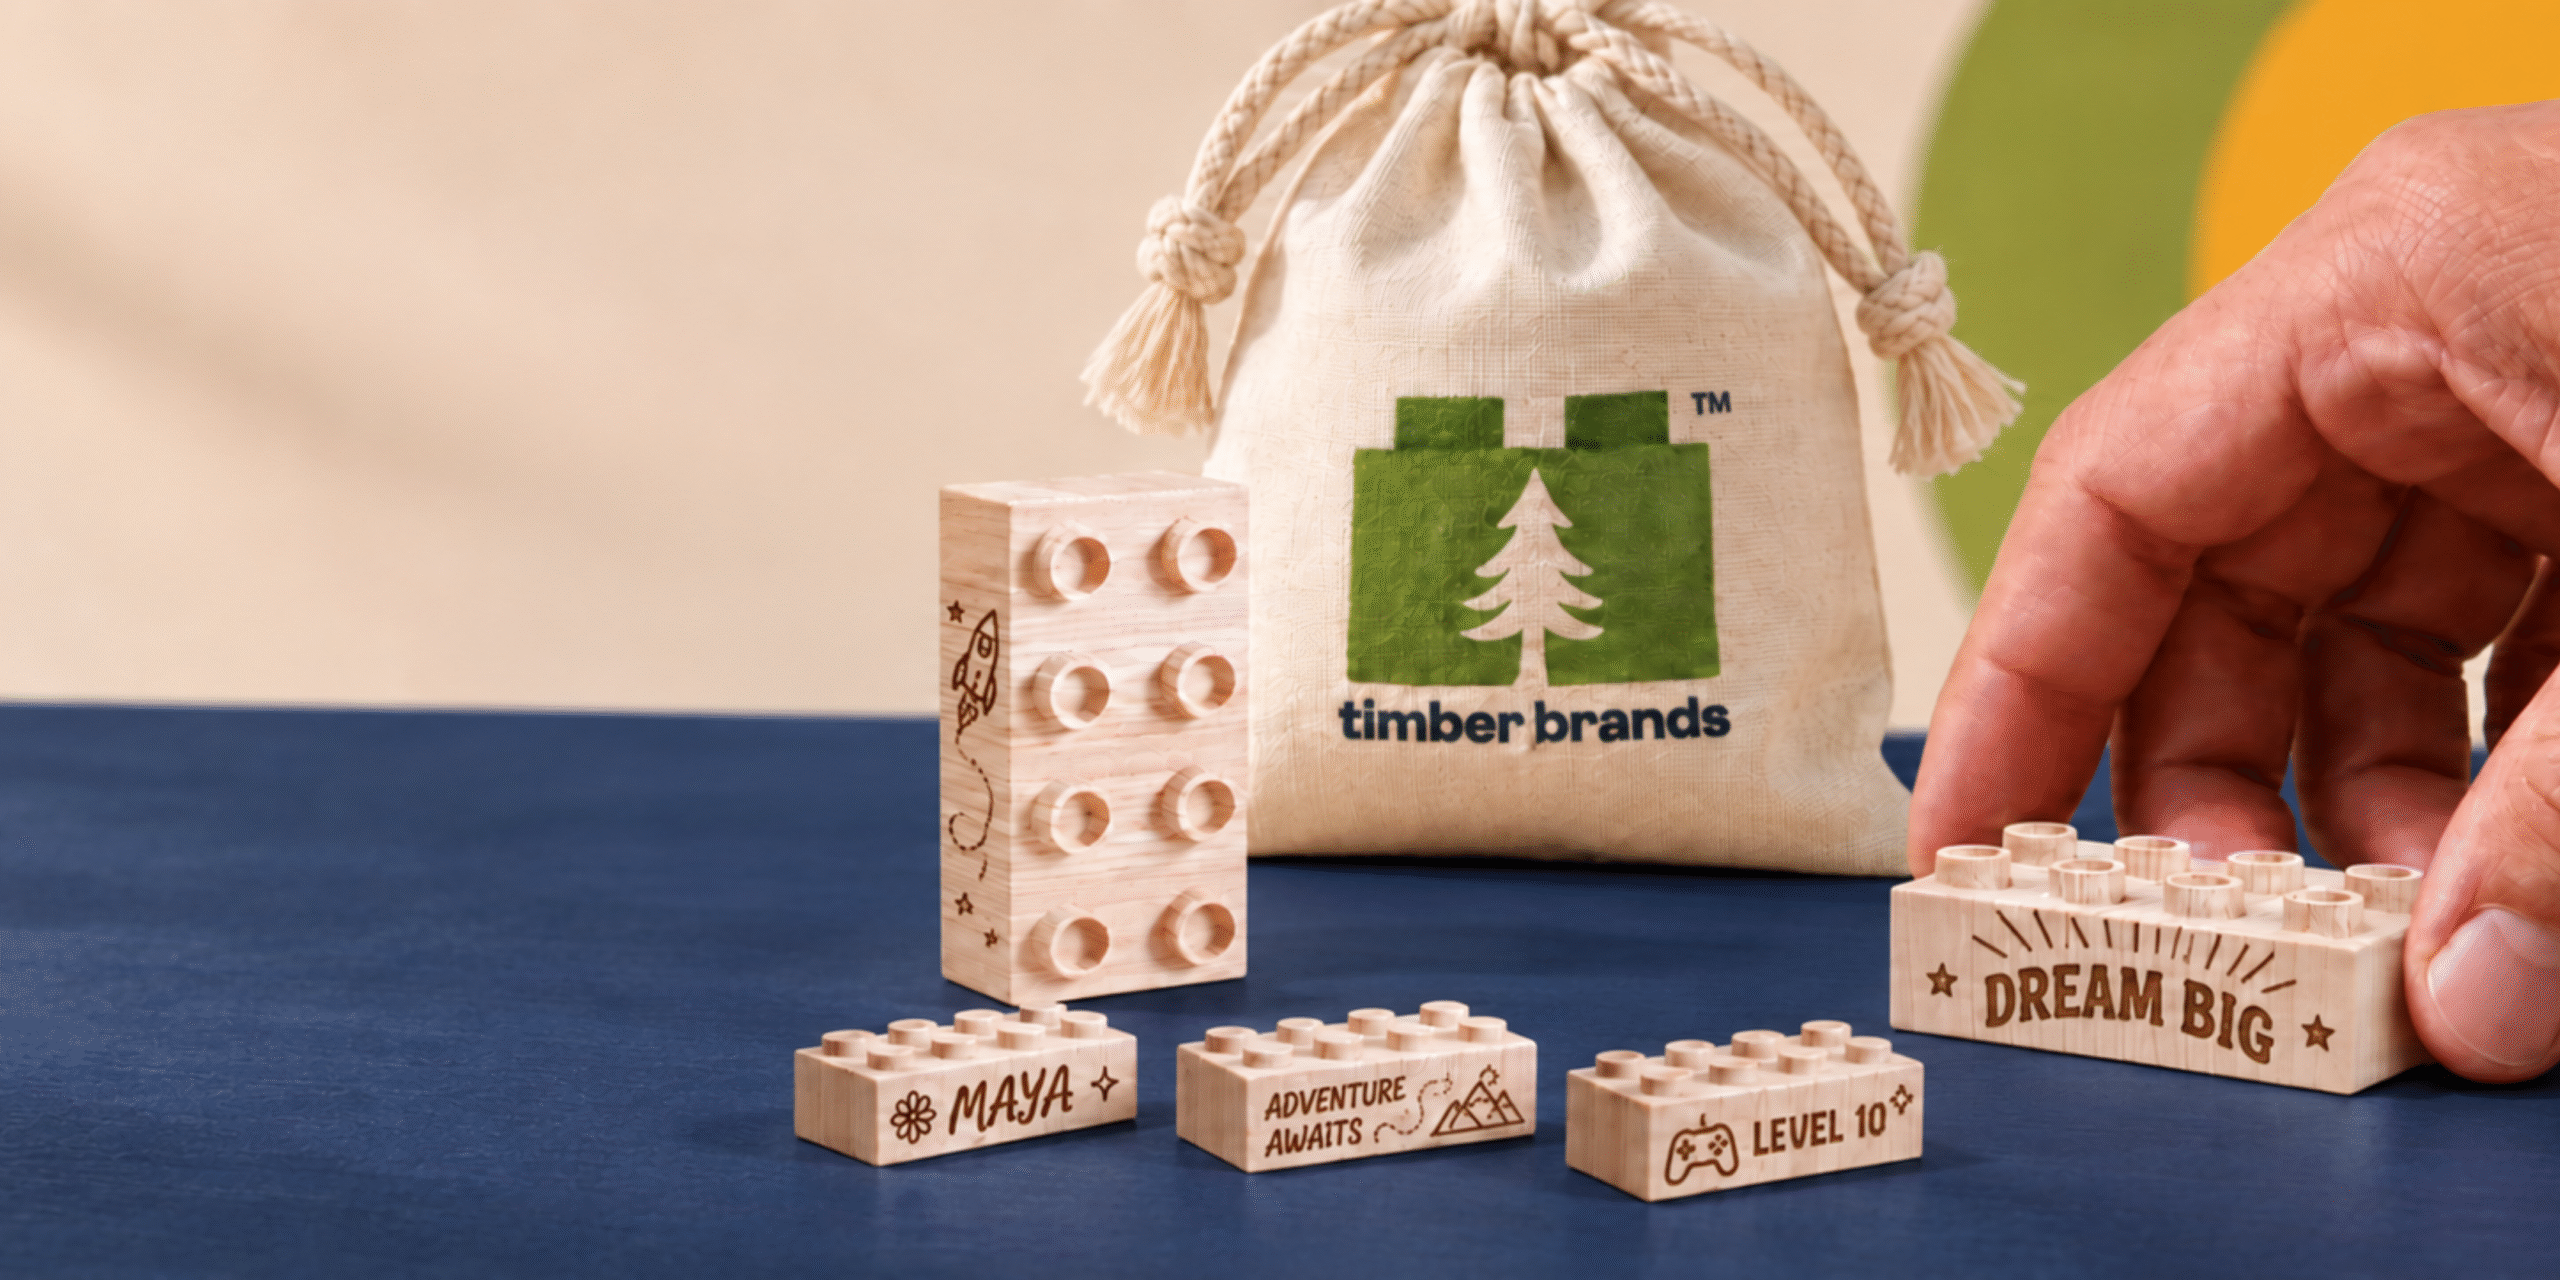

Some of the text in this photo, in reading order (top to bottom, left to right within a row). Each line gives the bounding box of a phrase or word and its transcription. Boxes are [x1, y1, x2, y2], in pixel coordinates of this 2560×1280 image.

[1691, 391, 1732, 415] TM
[1338, 696, 1731, 743] timber brands
[1984, 962, 2275, 1065] DREAM BIG
[949, 1064, 1074, 1135] MAYA
[1264, 1075, 1407, 1121] ADVENTURE
[1264, 1117, 1364, 1158] AWAITS
[1753, 1101, 1887, 1157] LEVEL 10
